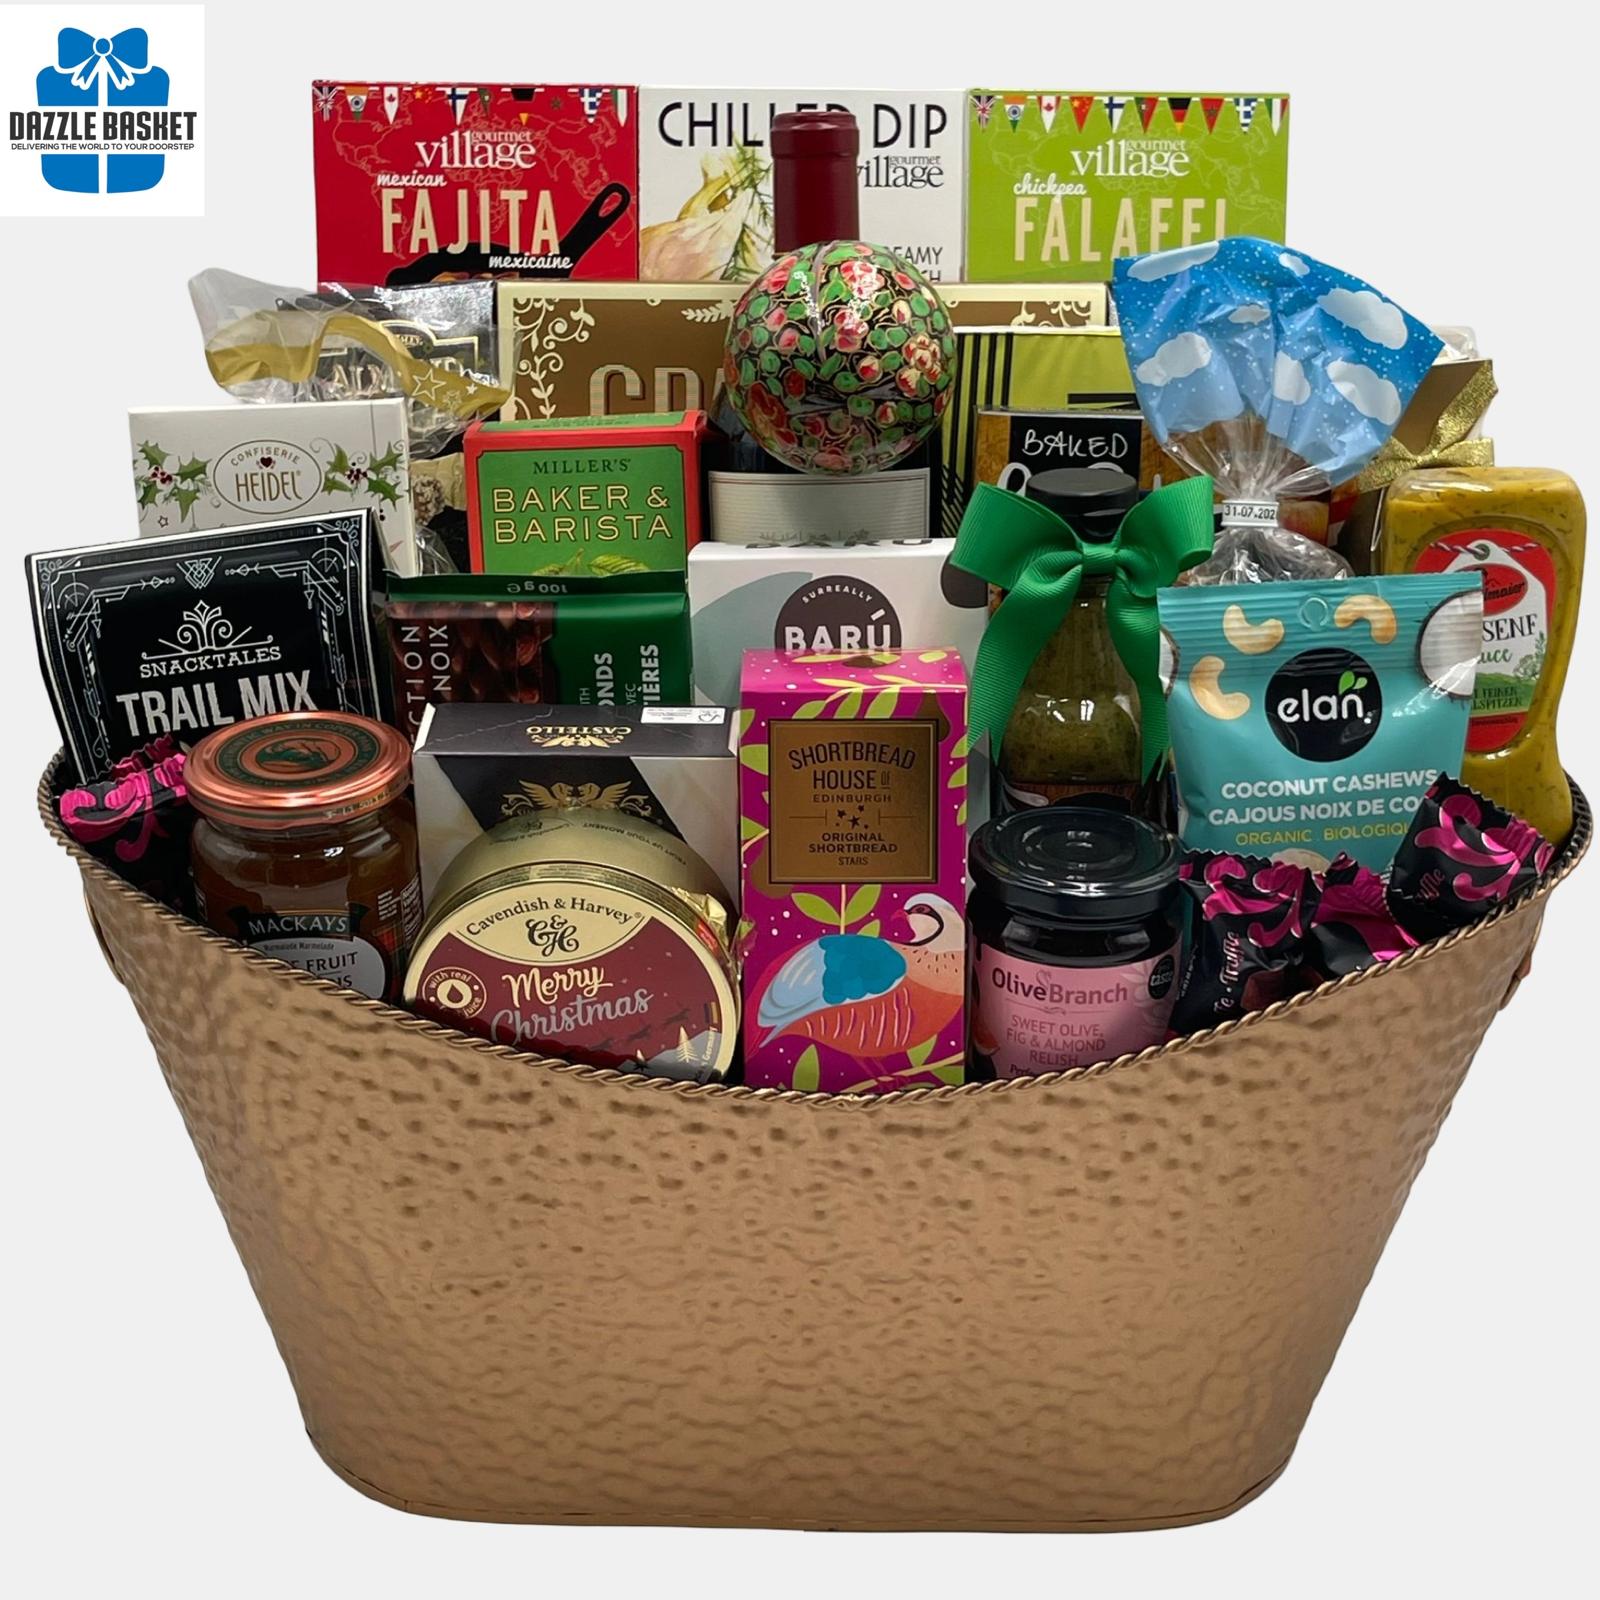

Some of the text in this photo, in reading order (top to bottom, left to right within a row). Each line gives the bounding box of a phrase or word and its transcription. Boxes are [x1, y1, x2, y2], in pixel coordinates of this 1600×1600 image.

[658, 102, 948, 148] CHIL DIP
[471, 130, 532, 145] gourmet
[1124, 139, 1187, 153] gourmet
[415, 131, 537, 169] village
[890, 155, 941, 167] gourmet
[1071, 139, 1191, 178] village
[377, 170, 447, 187] mexican
[1014, 173, 1087, 202] chickpea
[381, 188, 561, 255] FAJITA
[489, 252, 573, 269] mexicaine
[884, 246, 943, 265] EAMY
[1021, 428, 1128, 459] BAKED
[230, 446, 300, 467] CONFISERIE
[235, 470, 302, 502] HEIDEL
[492, 484, 670, 513] BAKER &
[494, 514, 673, 543] BARISTA
[802, 585, 873, 604] SURREALLY
[784, 608, 891, 653] BARÚ
[140, 646, 282, 679] SNACKTALES
[428, 625, 452, 691] NOIX
[637, 644, 660, 706] IÈRES
[116, 670, 319, 737] TRAIL MIX
[579, 687, 590, 705] ITH
[625, 683, 637, 705] VEC
[526, 725, 632, 735] CASTELLO
[788, 741, 916, 770] SHORTBREAD
[813, 769, 890, 790] HOUSE OF
[1221, 769, 1438, 800] COCONUT CASHEWS
[813, 794, 892, 803] EDINBURGH
[1208, 805, 1296, 826] CAJOUS
[1300, 802, 1352, 821] NOIX
[1356, 800, 1385, 817] DE
[822, 832, 885, 842] ORIGINAL
[1235, 829, 1313, 845] ORGANIC
[809, 844, 898, 853] SHORTBREAD
[838, 857, 868, 866] STARS
[248, 915, 349, 936] MACKAYS
[466, 897, 633, 937] Cavendish & Harvey
[306, 951, 358, 972] FRUIT
[451, 971, 472, 983] real
[502, 967, 614, 1008] Merry
[491, 988, 653, 1043] Christmas
[1011, 1015, 1055, 1036] SWEET
[1007, 1028, 1106, 1052] FIG & ALMOND
[1030, 1050, 1079, 1066] RELISH
